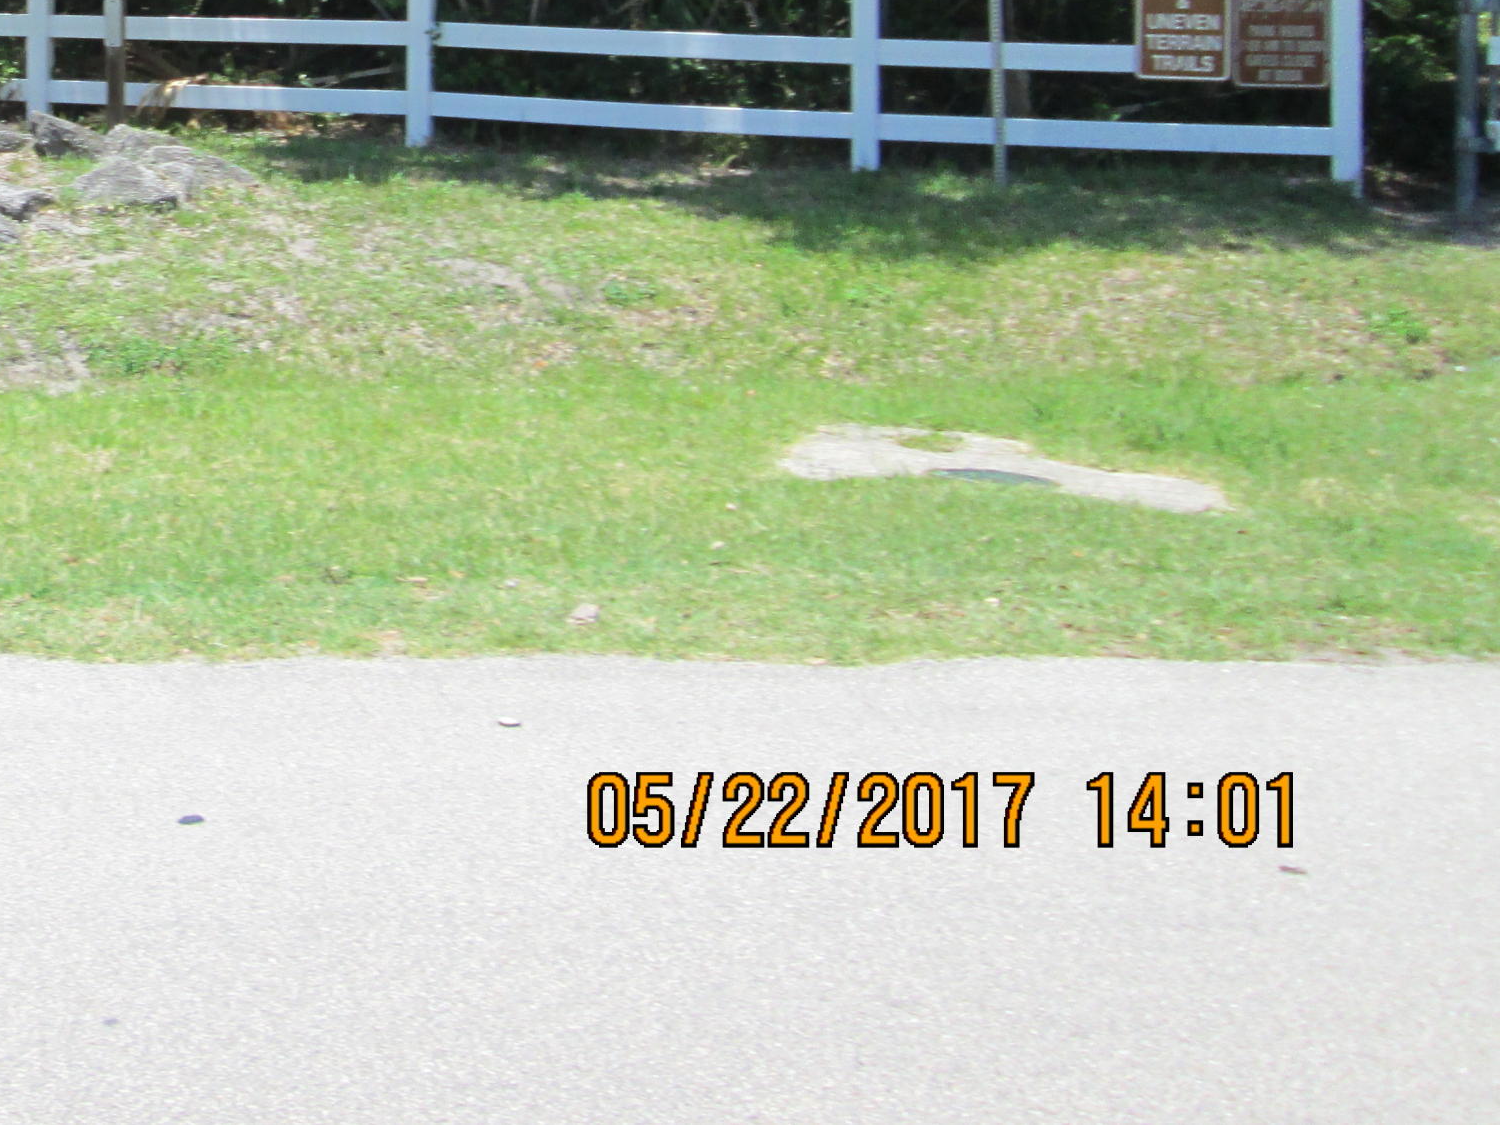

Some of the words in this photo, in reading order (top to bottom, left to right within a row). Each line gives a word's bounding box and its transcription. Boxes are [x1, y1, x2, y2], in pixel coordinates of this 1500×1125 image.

[1146, 13, 1221, 30] UNEVEN
[1145, 34, 1222, 51] TERRAIN
[1151, 55, 1216, 72] TRAILS
